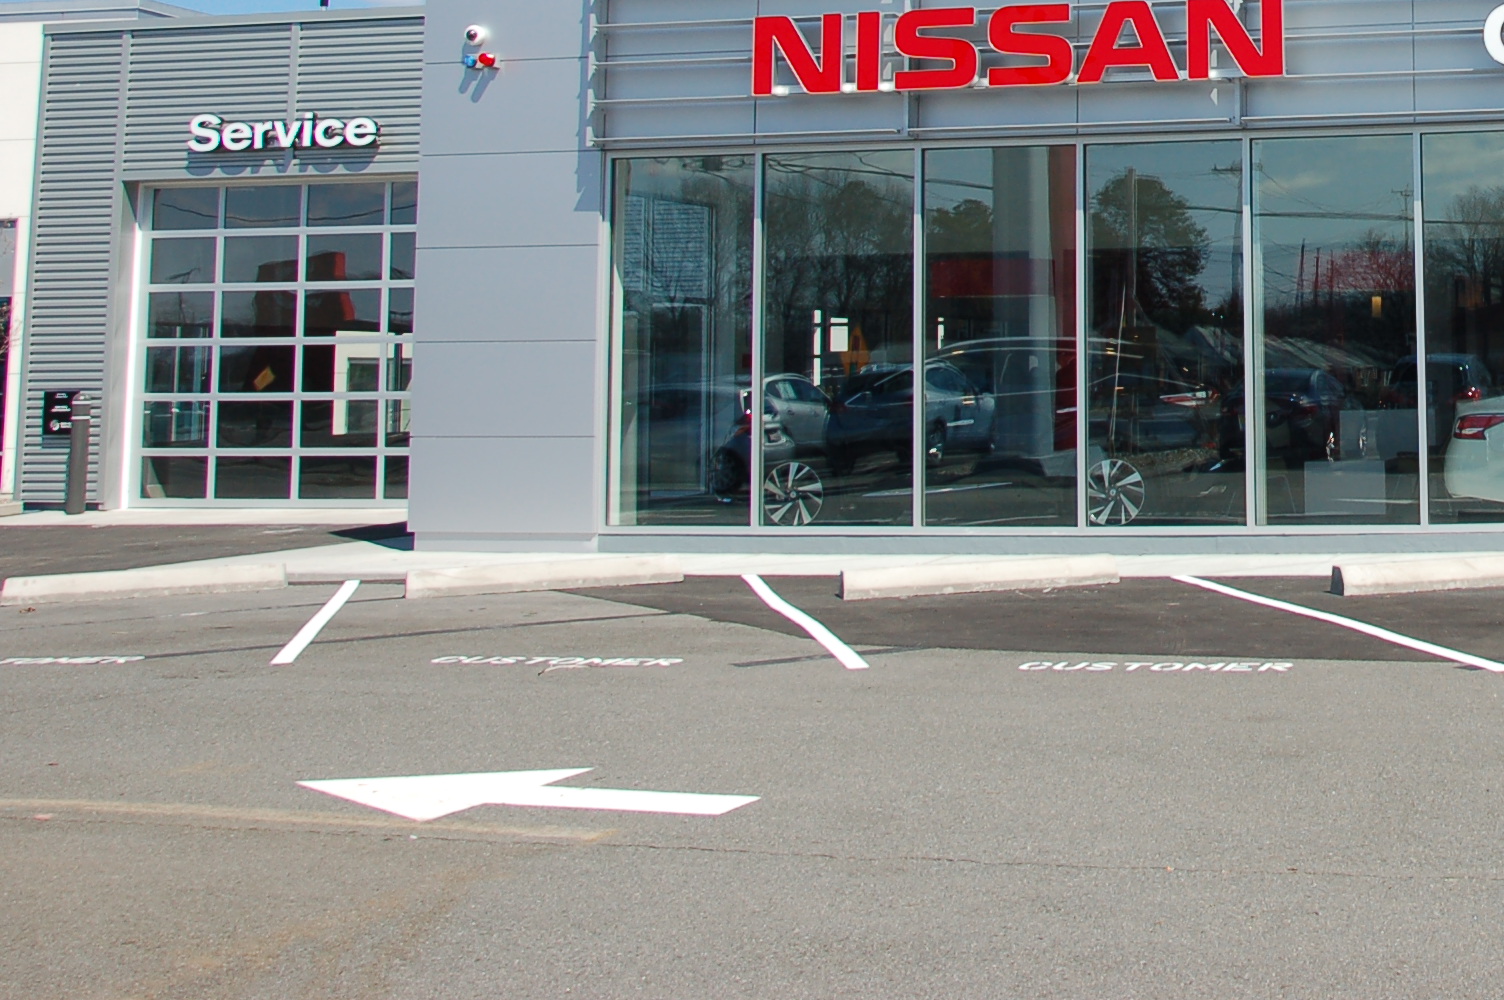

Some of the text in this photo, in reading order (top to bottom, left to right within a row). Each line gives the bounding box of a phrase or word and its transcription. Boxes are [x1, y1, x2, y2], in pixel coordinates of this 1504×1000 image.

[187, 112, 378, 152] Service
[430, 655, 684, 666] CUSTOMER
[1017, 661, 1294, 672] CUSTOMER
